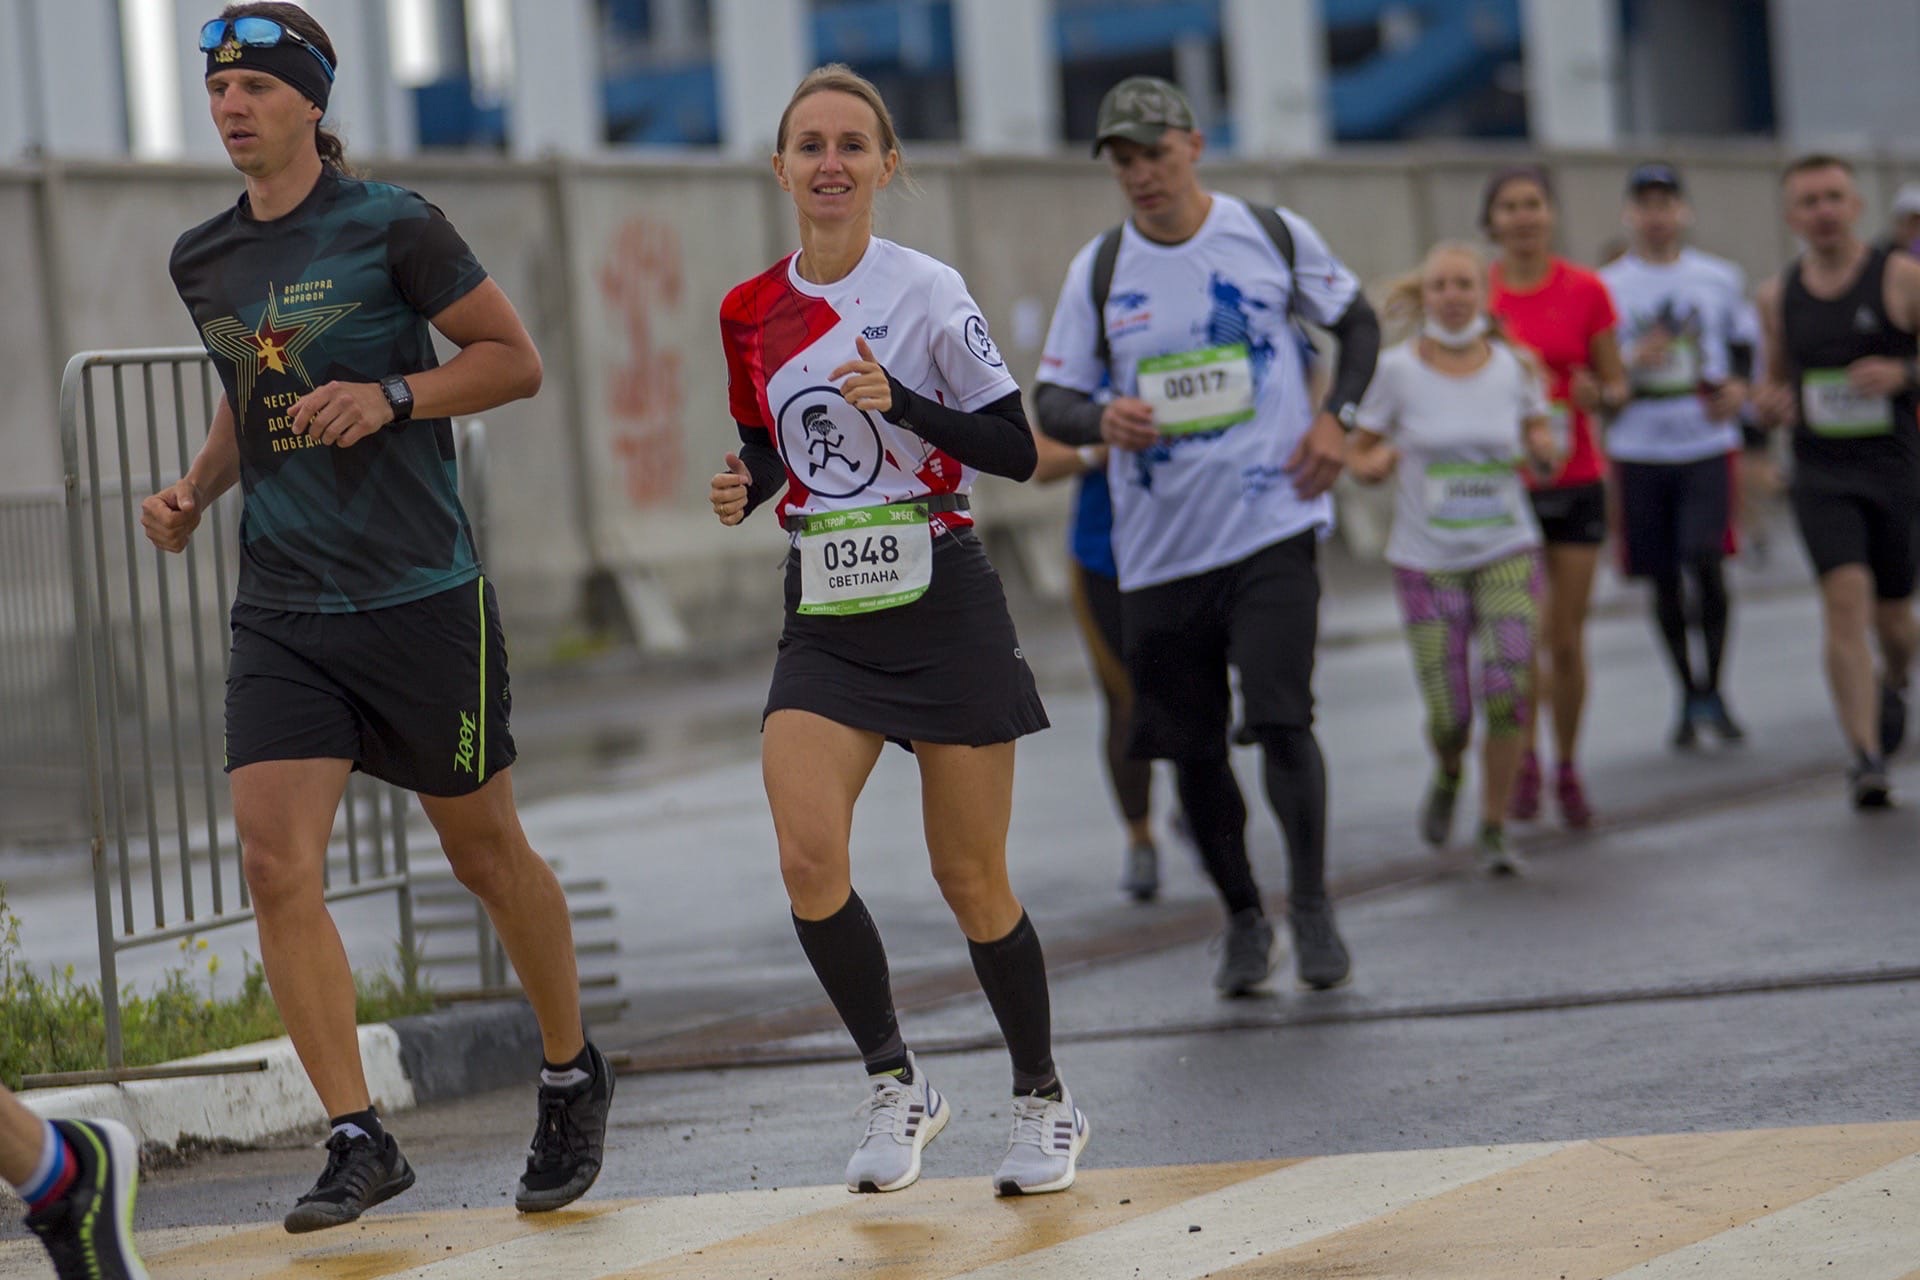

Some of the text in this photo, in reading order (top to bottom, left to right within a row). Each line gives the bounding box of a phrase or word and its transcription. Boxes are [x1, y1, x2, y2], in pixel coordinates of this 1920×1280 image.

[284, 279, 333, 295] ВОЛГОГРАД
[283, 291, 324, 305] МАРАФОН
[1164, 369, 1226, 401] 0017
[823, 535, 900, 571] 0348
[828, 569, 900, 589] СВЕТЛАНА
